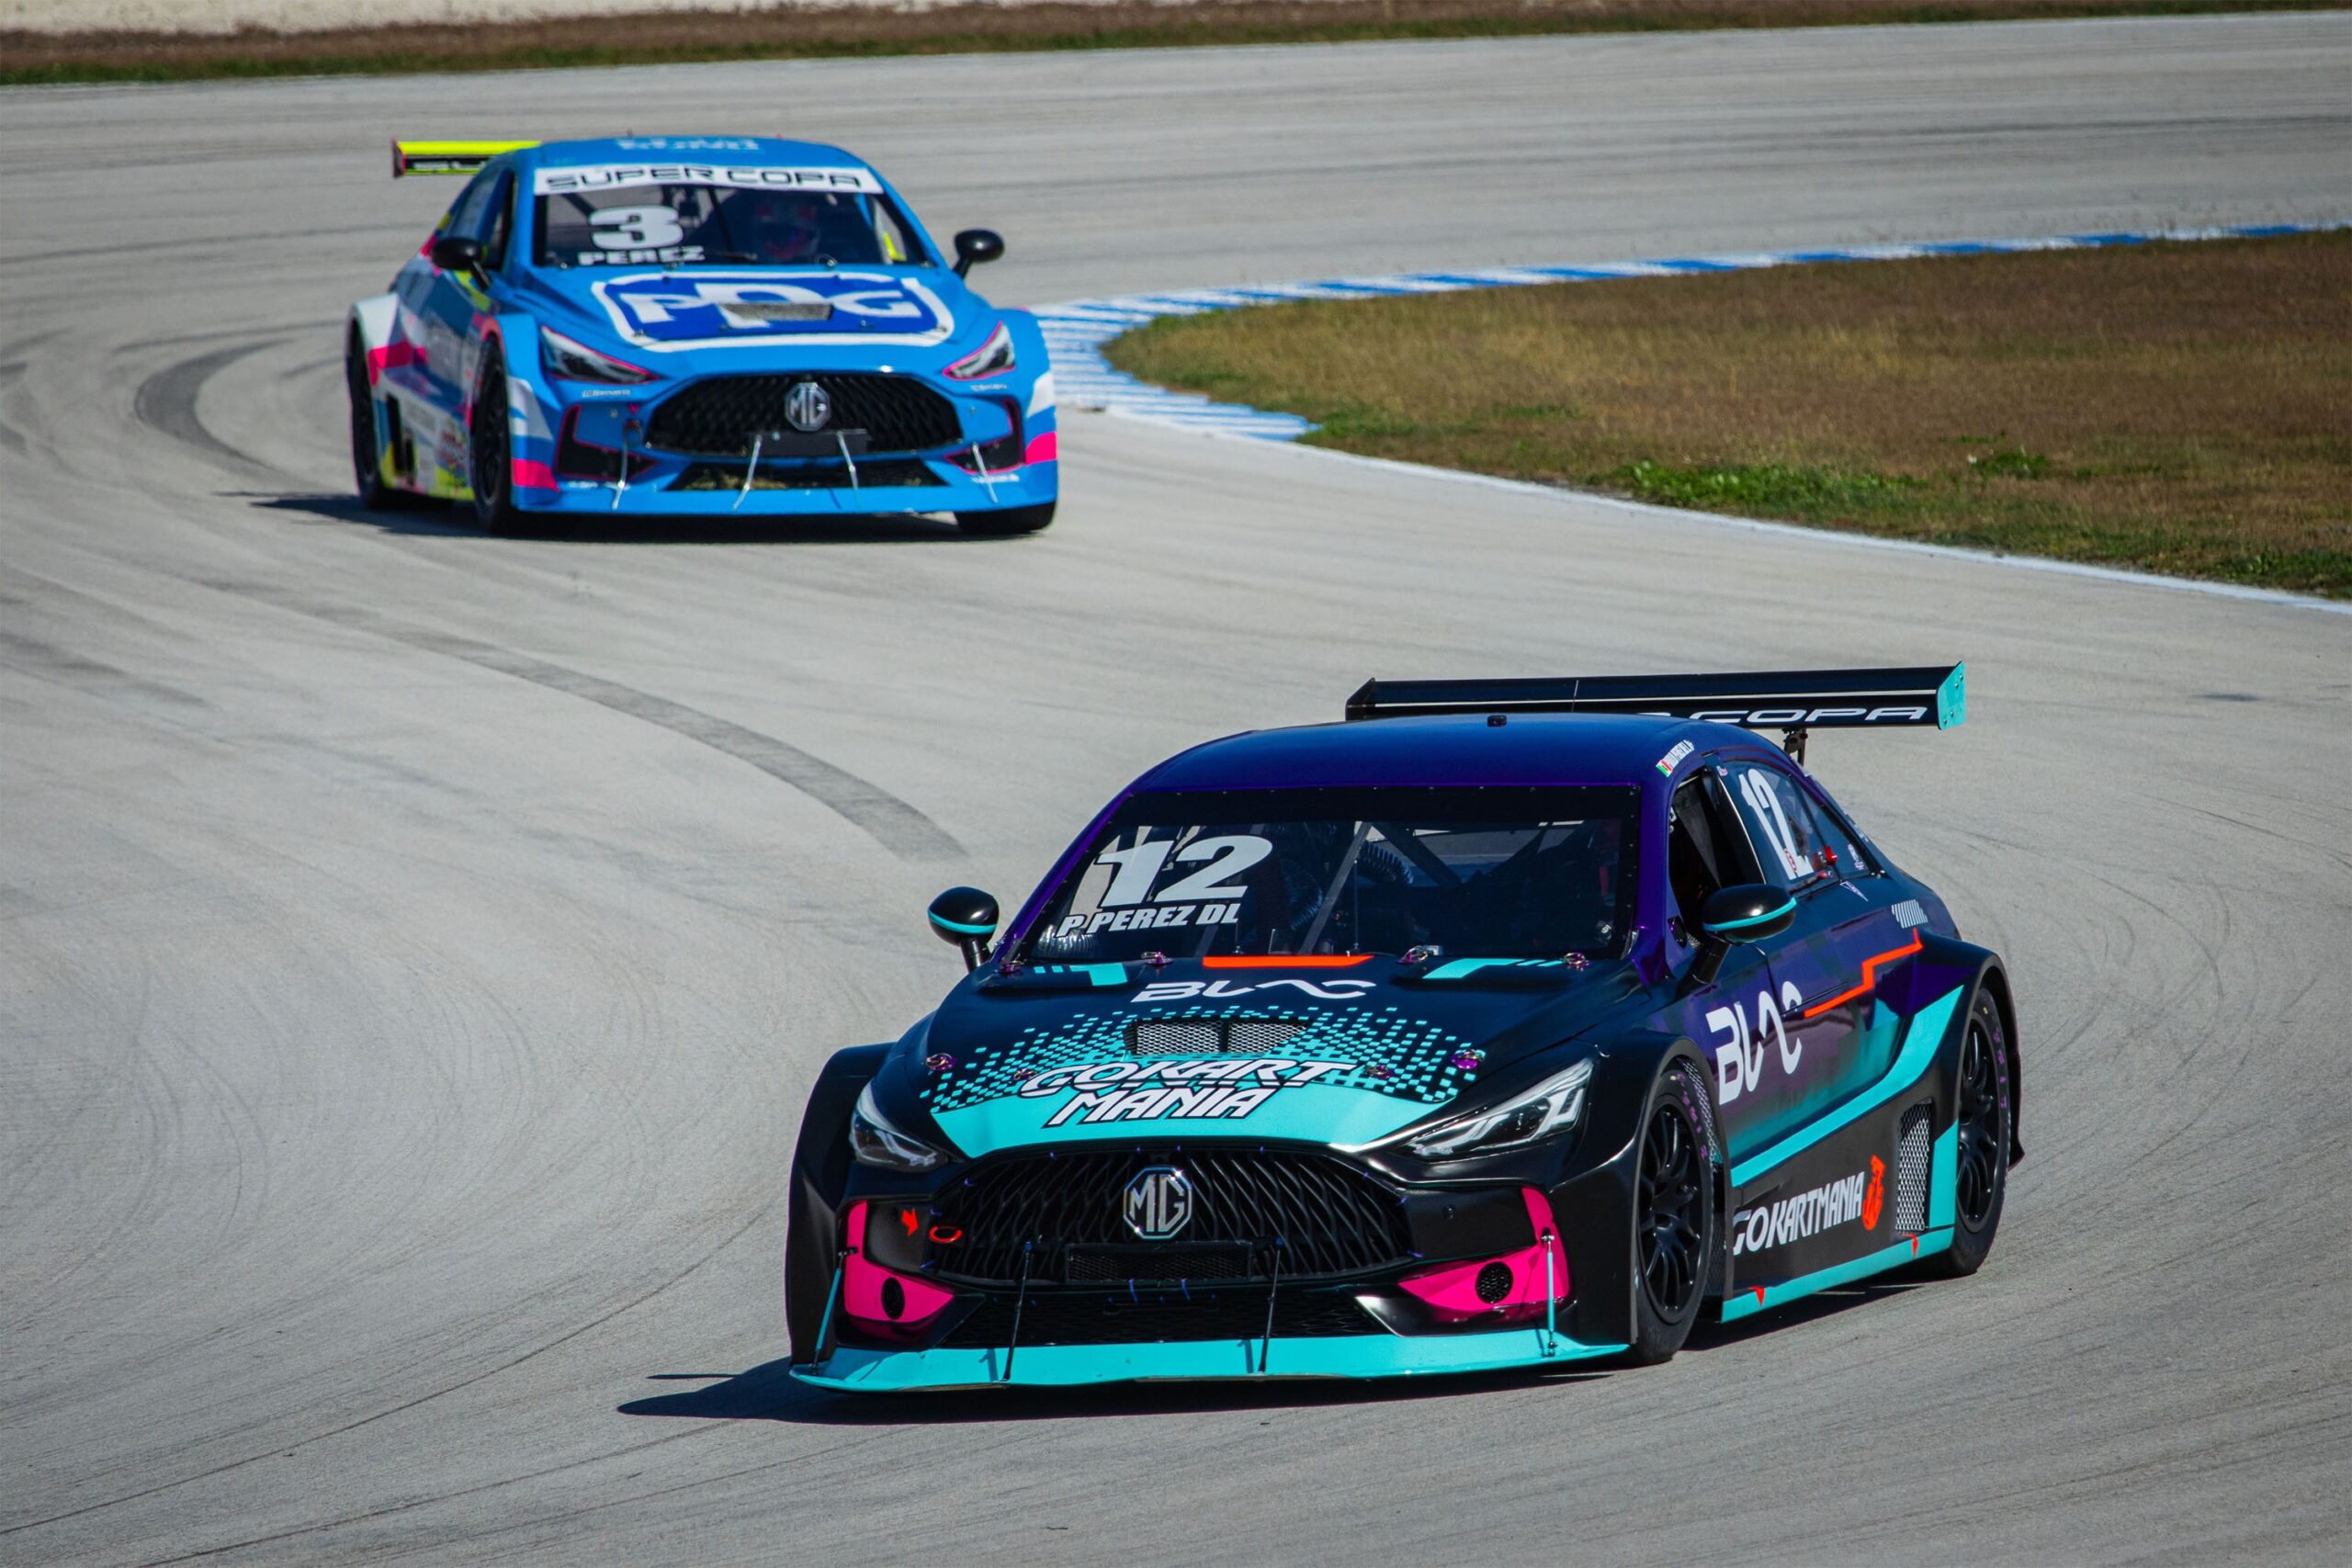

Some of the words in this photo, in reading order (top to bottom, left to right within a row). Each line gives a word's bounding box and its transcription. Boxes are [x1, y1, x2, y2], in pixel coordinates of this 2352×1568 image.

[547, 166, 714, 191] SUPER
[728, 169, 861, 188] COPA
[589, 204, 684, 251] 3
[577, 245, 706, 266] PEREZ
[1690, 706, 1928, 724] COPA
[1738, 769, 1815, 881] 12
[1096, 834, 1273, 908] 12
[1086, 905, 1197, 934] PEREZ
[1195, 903, 1241, 925] DL
[1020, 1058, 1358, 1098] GOKART
[1041, 1088, 1281, 1128] MANIA
[1129, 1174, 1185, 1232] MG
